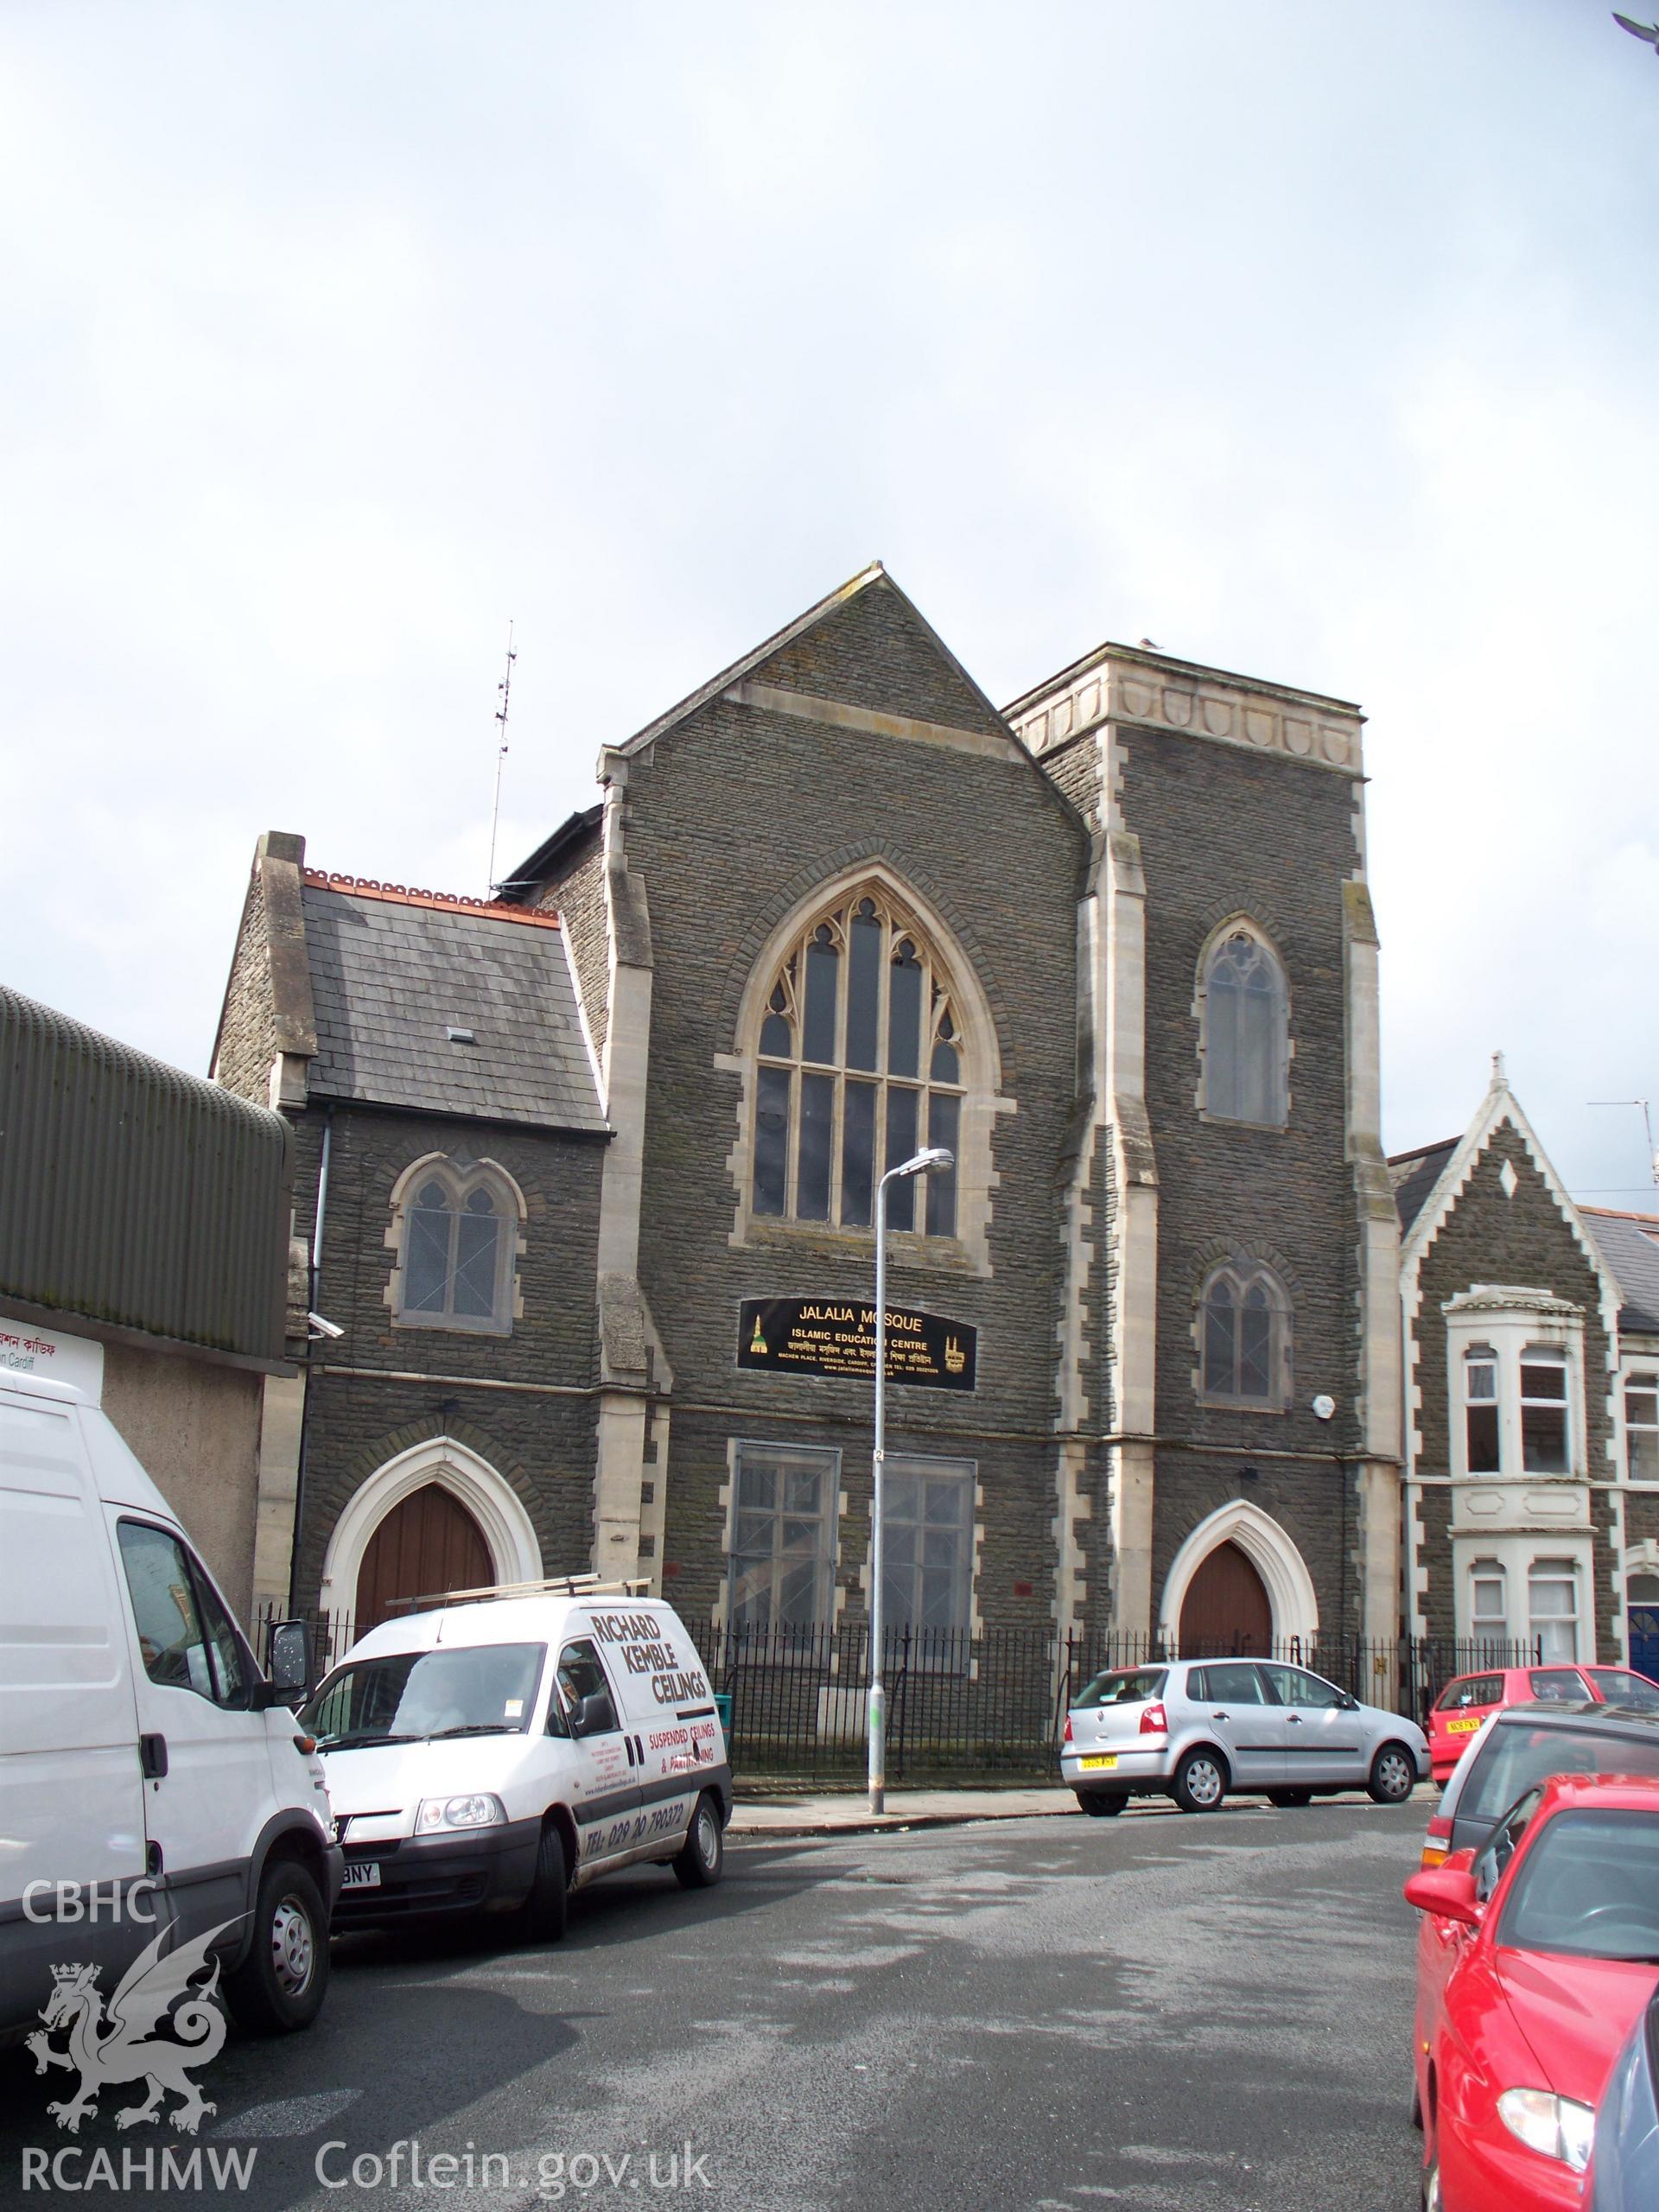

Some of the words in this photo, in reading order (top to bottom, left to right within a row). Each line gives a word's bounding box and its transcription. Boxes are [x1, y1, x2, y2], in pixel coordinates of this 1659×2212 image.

[799, 1306, 855, 1322] JALALIA
[791, 1328, 830, 1340] ISLAMIC
[891, 1339, 927, 1351] CENTRE
[857, 1324, 865, 1333] &
[9, 1352, 35, 1370] Cardiff
[590, 1614, 661, 1643] RICHARD
[620, 1643, 679, 1674] KEMBLE
[652, 1671, 707, 1704] CEILINGS
[649, 1728, 689, 1751] SUSPENDED
[690, 1722, 715, 1741] CEILINGS
[661, 1758, 667, 1774] &
[608, 1820, 631, 1847] 029
[632, 1815, 647, 1840] 20
[648, 1802, 683, 1834] 790372
